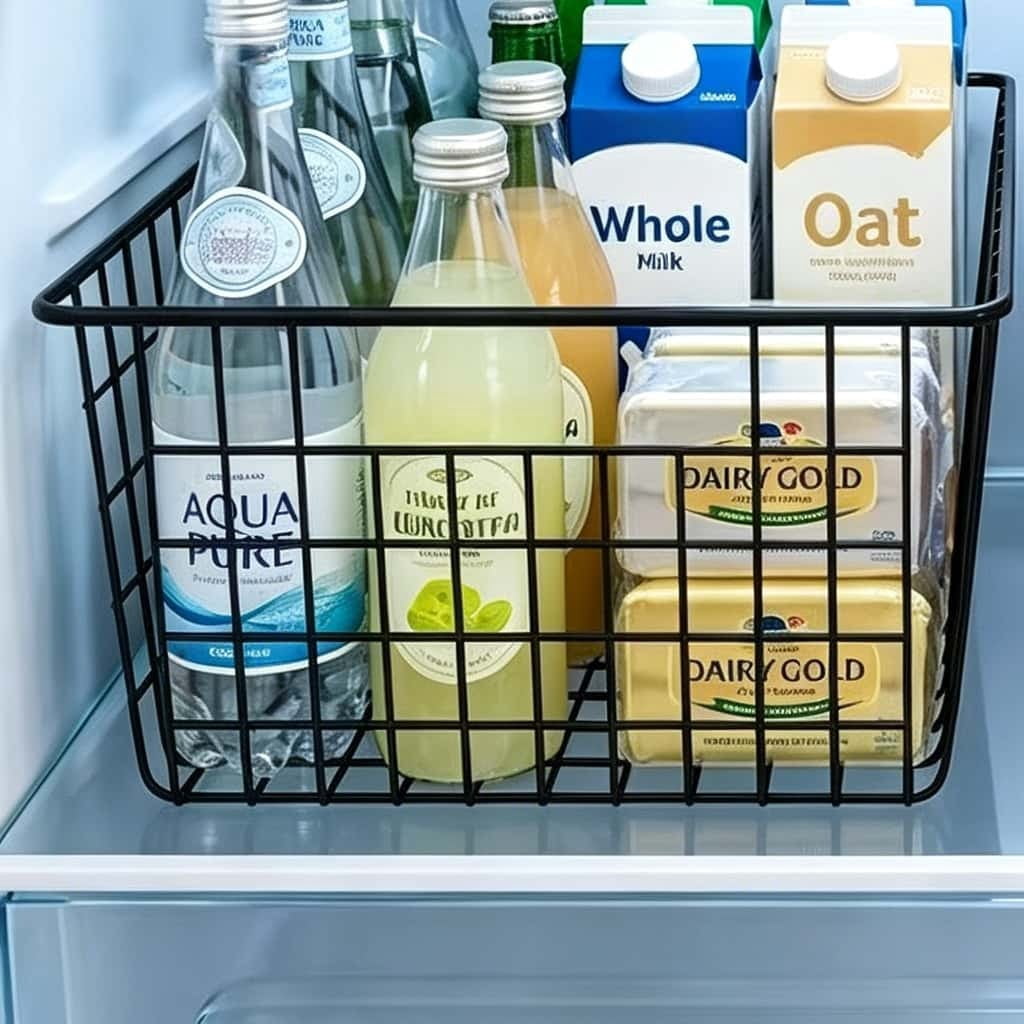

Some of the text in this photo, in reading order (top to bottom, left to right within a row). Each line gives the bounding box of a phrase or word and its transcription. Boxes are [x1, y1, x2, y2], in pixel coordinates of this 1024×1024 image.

[590, 205, 730, 243] Whole
[804, 192, 922, 247] Oat
[777, 465, 862, 490] GOD
[183, 491, 299, 535] AQUA
[188, 531, 293, 569] PURE
[780, 658, 866, 682] GOD
